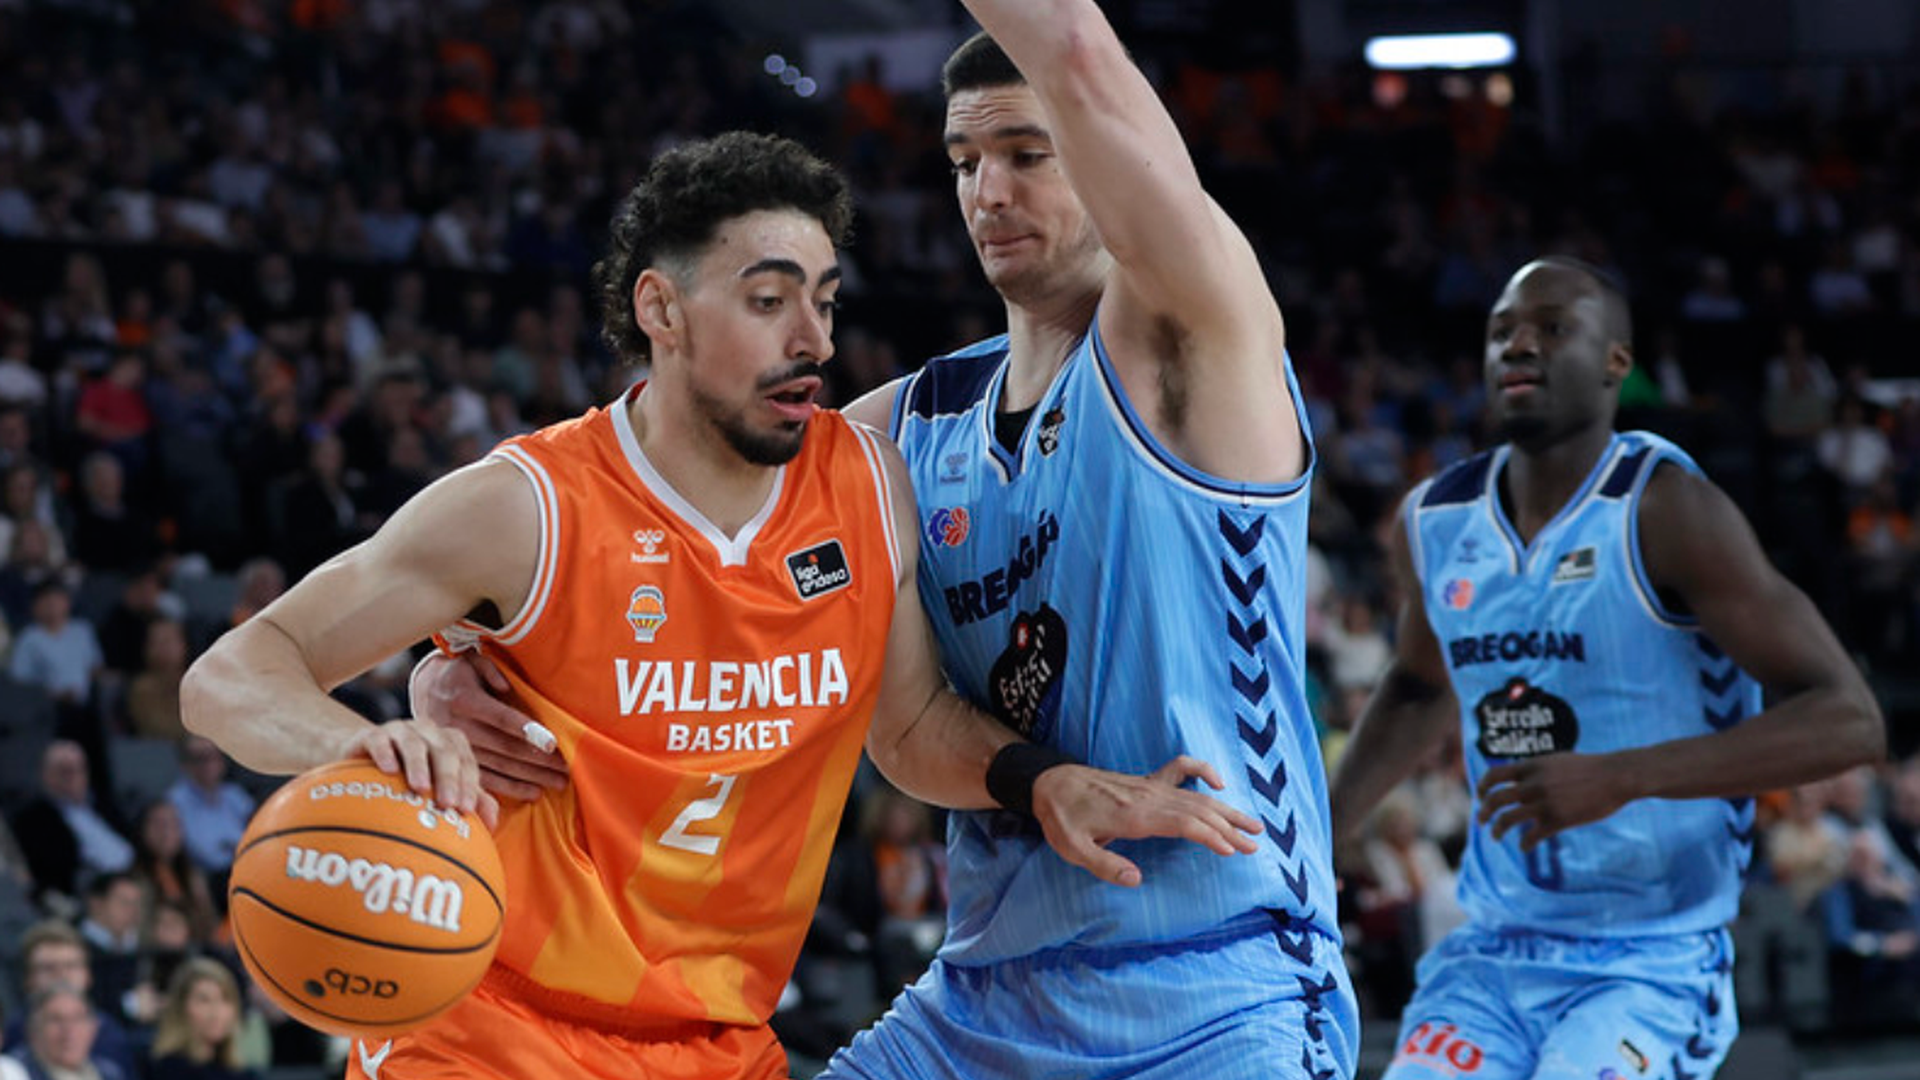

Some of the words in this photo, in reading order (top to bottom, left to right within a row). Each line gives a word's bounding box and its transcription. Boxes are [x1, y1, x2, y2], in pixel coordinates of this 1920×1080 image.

[796, 564, 819, 580] liga
[801, 569, 846, 593] endesa
[614, 648, 849, 716] VALENCIA
[666, 719, 795, 751] BASKET
[657, 773, 737, 856] 2
[286, 846, 462, 933] Wilson
[324, 967, 399, 999] acb
